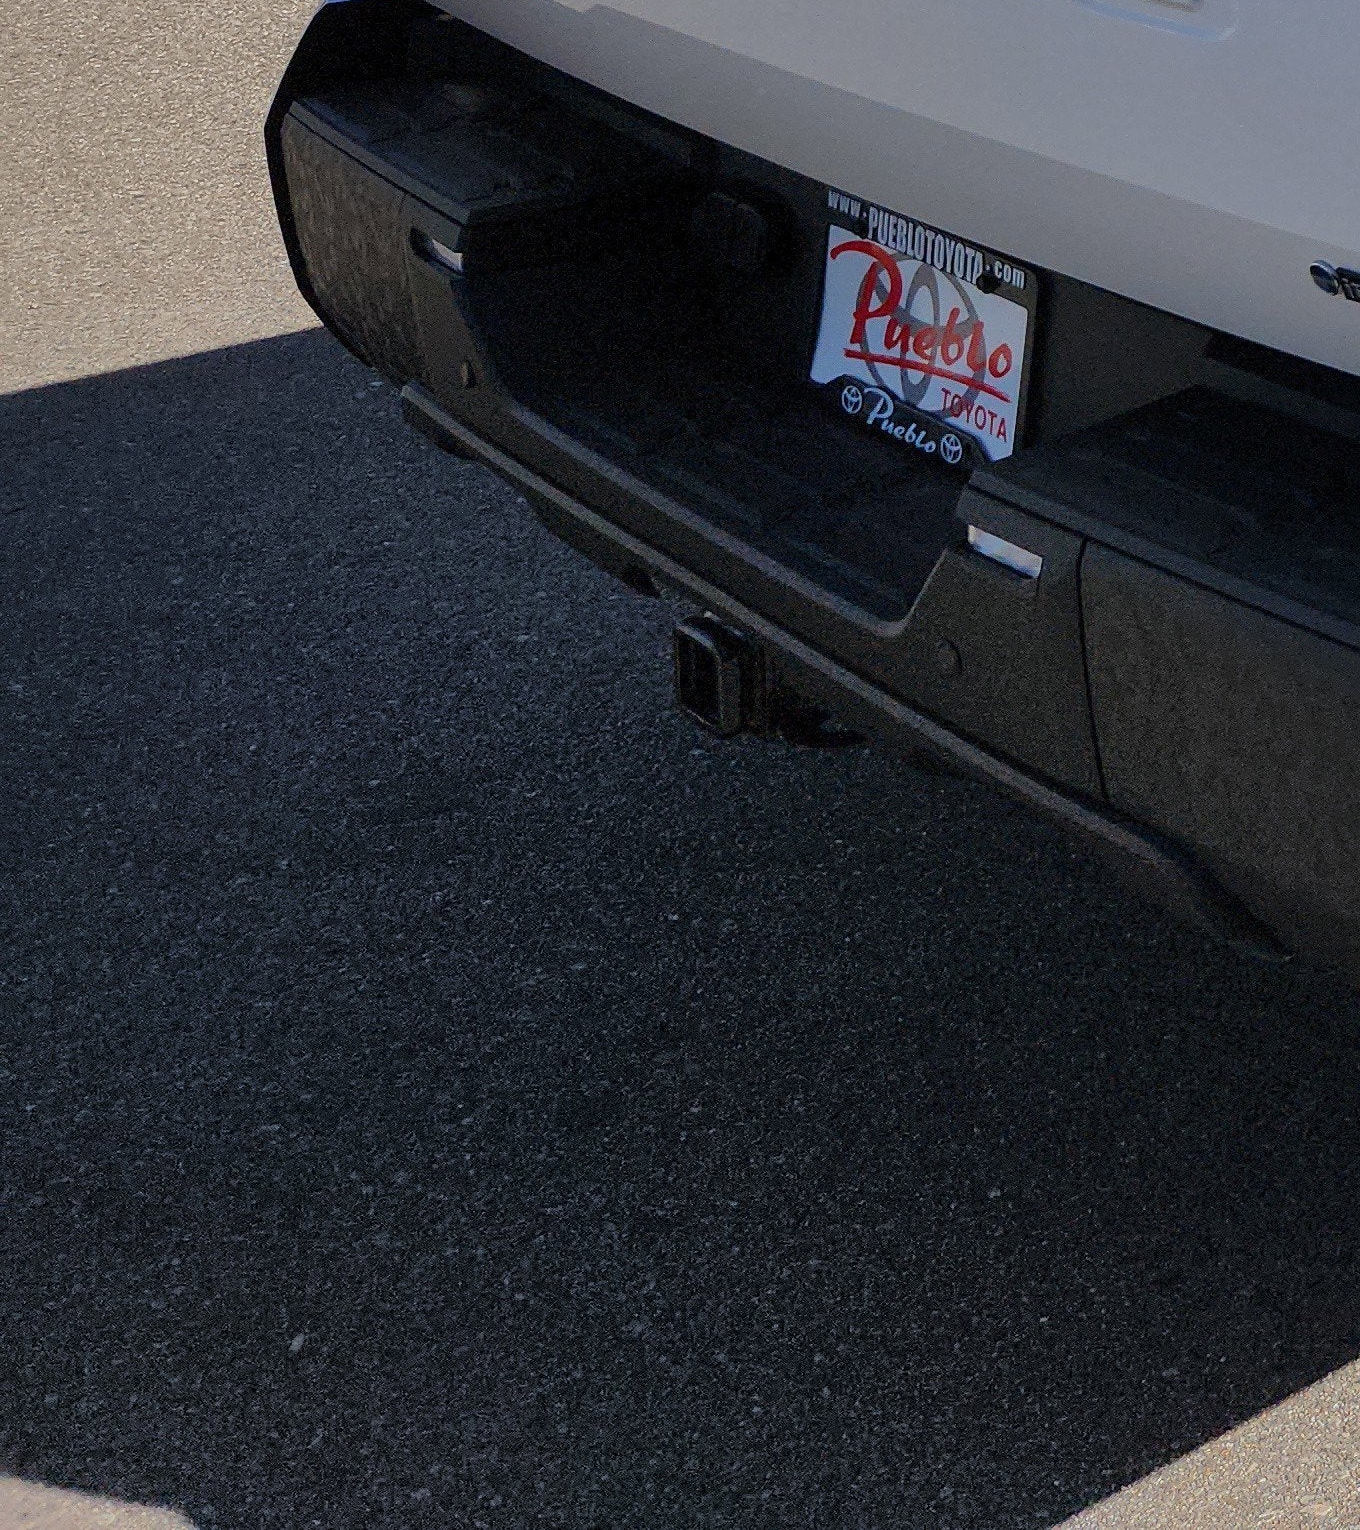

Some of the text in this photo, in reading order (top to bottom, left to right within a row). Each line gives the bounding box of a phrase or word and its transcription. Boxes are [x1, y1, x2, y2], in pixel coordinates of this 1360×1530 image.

[830, 239, 1013, 379] Pueblo
[864, 386, 937, 455] Pueblo
[941, 387, 1008, 443] TOYOTA
